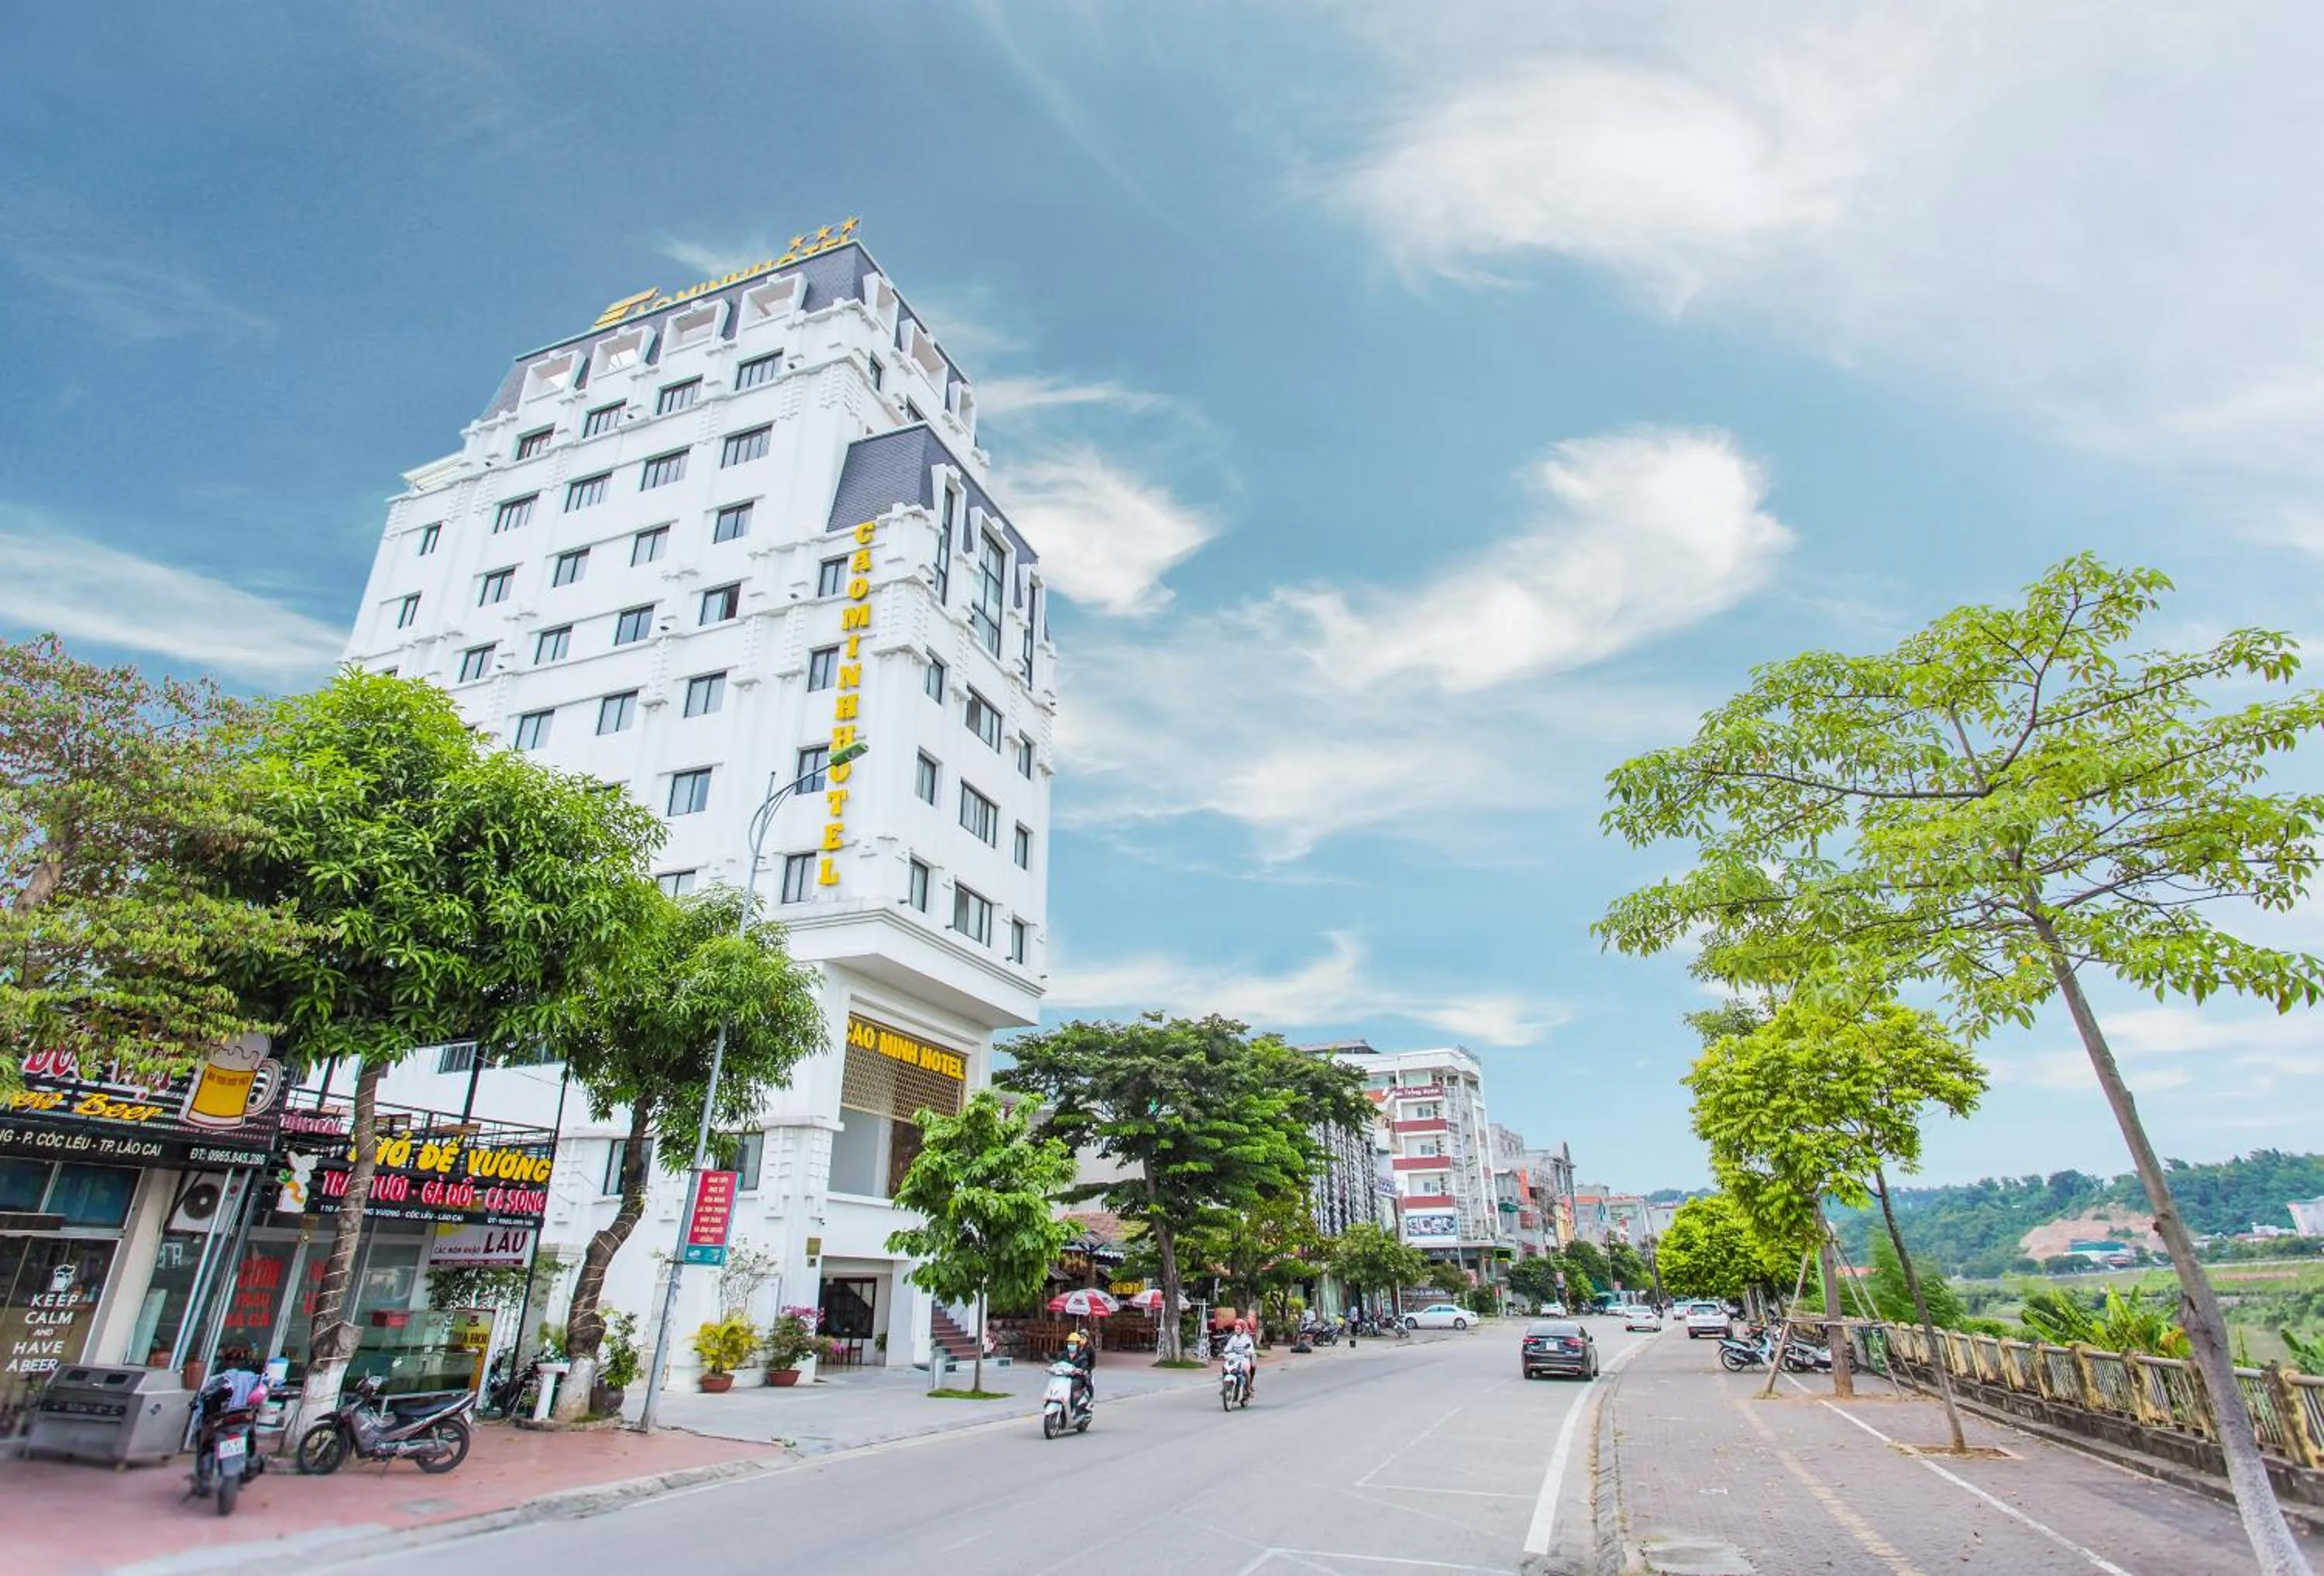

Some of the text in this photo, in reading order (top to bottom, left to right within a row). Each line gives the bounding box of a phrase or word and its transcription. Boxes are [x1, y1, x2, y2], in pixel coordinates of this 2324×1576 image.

[878, 1031, 919, 1065] MINH
[919, 1047, 966, 1081] HOTEL
[75, 1093, 163, 1120] Beer
[142, 1143, 162, 1157] CAI
[416, 1134, 464, 1174] ĐẾ
[466, 1148, 552, 1182] VƯƠNG
[30, 1293, 78, 1307] KEEP
[24, 1311, 74, 1325] CALM
[33, 1328, 53, 1337] AND
[12, 1340, 65, 1354] HAVE
[5, 1358, 59, 1372] A BEER
